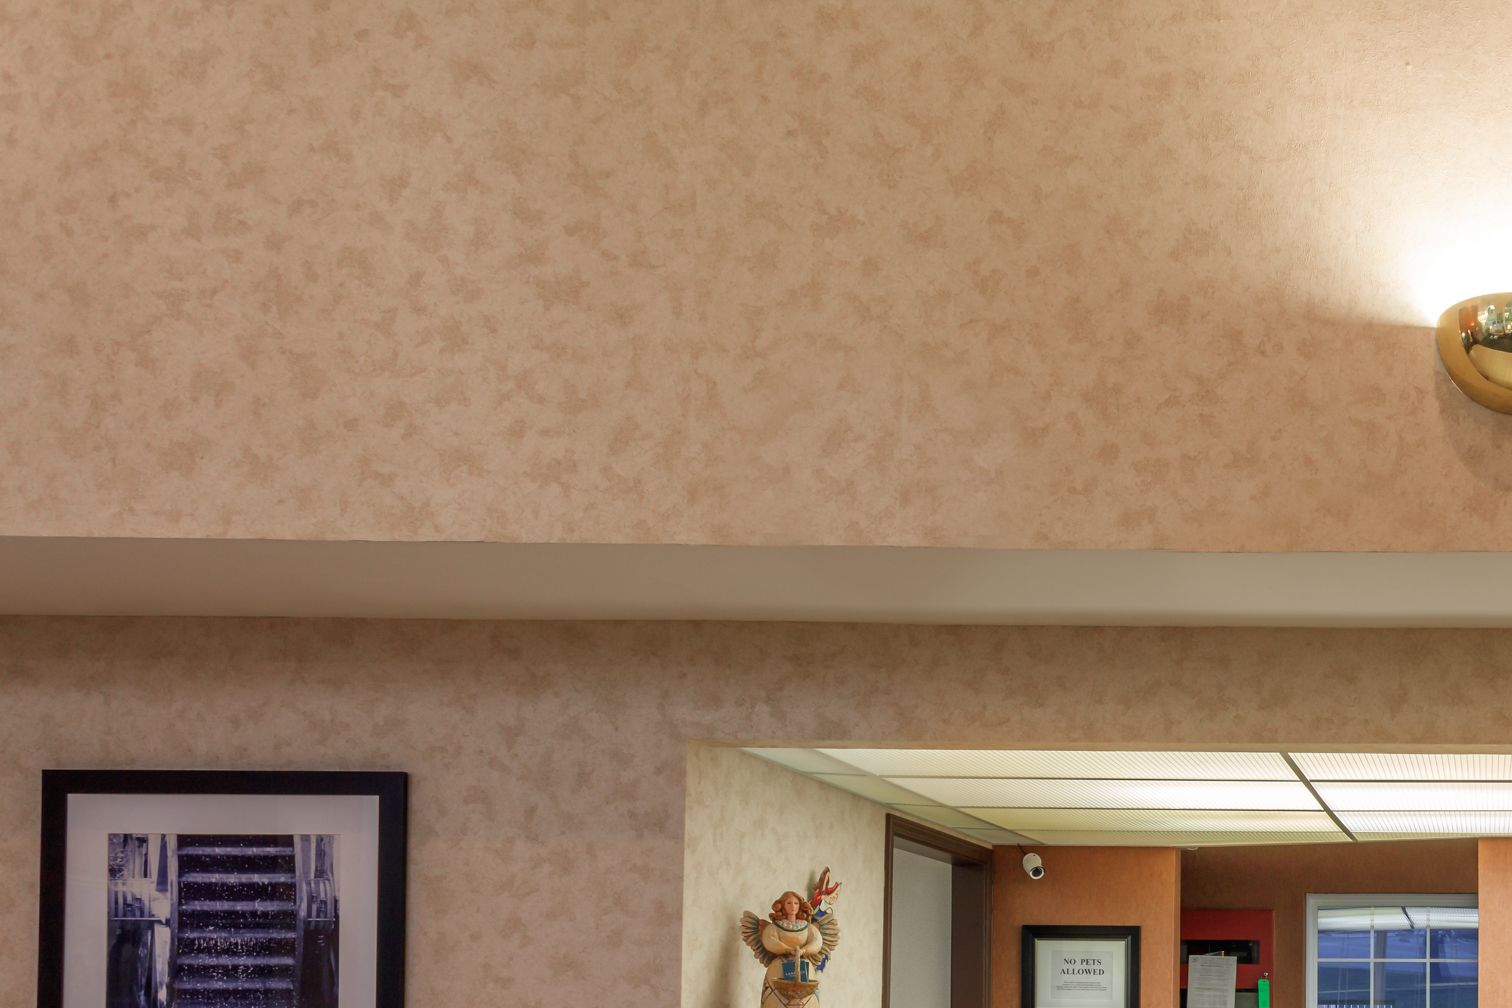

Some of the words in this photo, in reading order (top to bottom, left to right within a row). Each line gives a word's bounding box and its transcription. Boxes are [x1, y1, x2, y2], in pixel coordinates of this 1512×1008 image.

[1063, 958, 1076, 966] NO
[1080, 958, 1102, 966] PETS
[1060, 968, 1105, 976] ALLOWED
